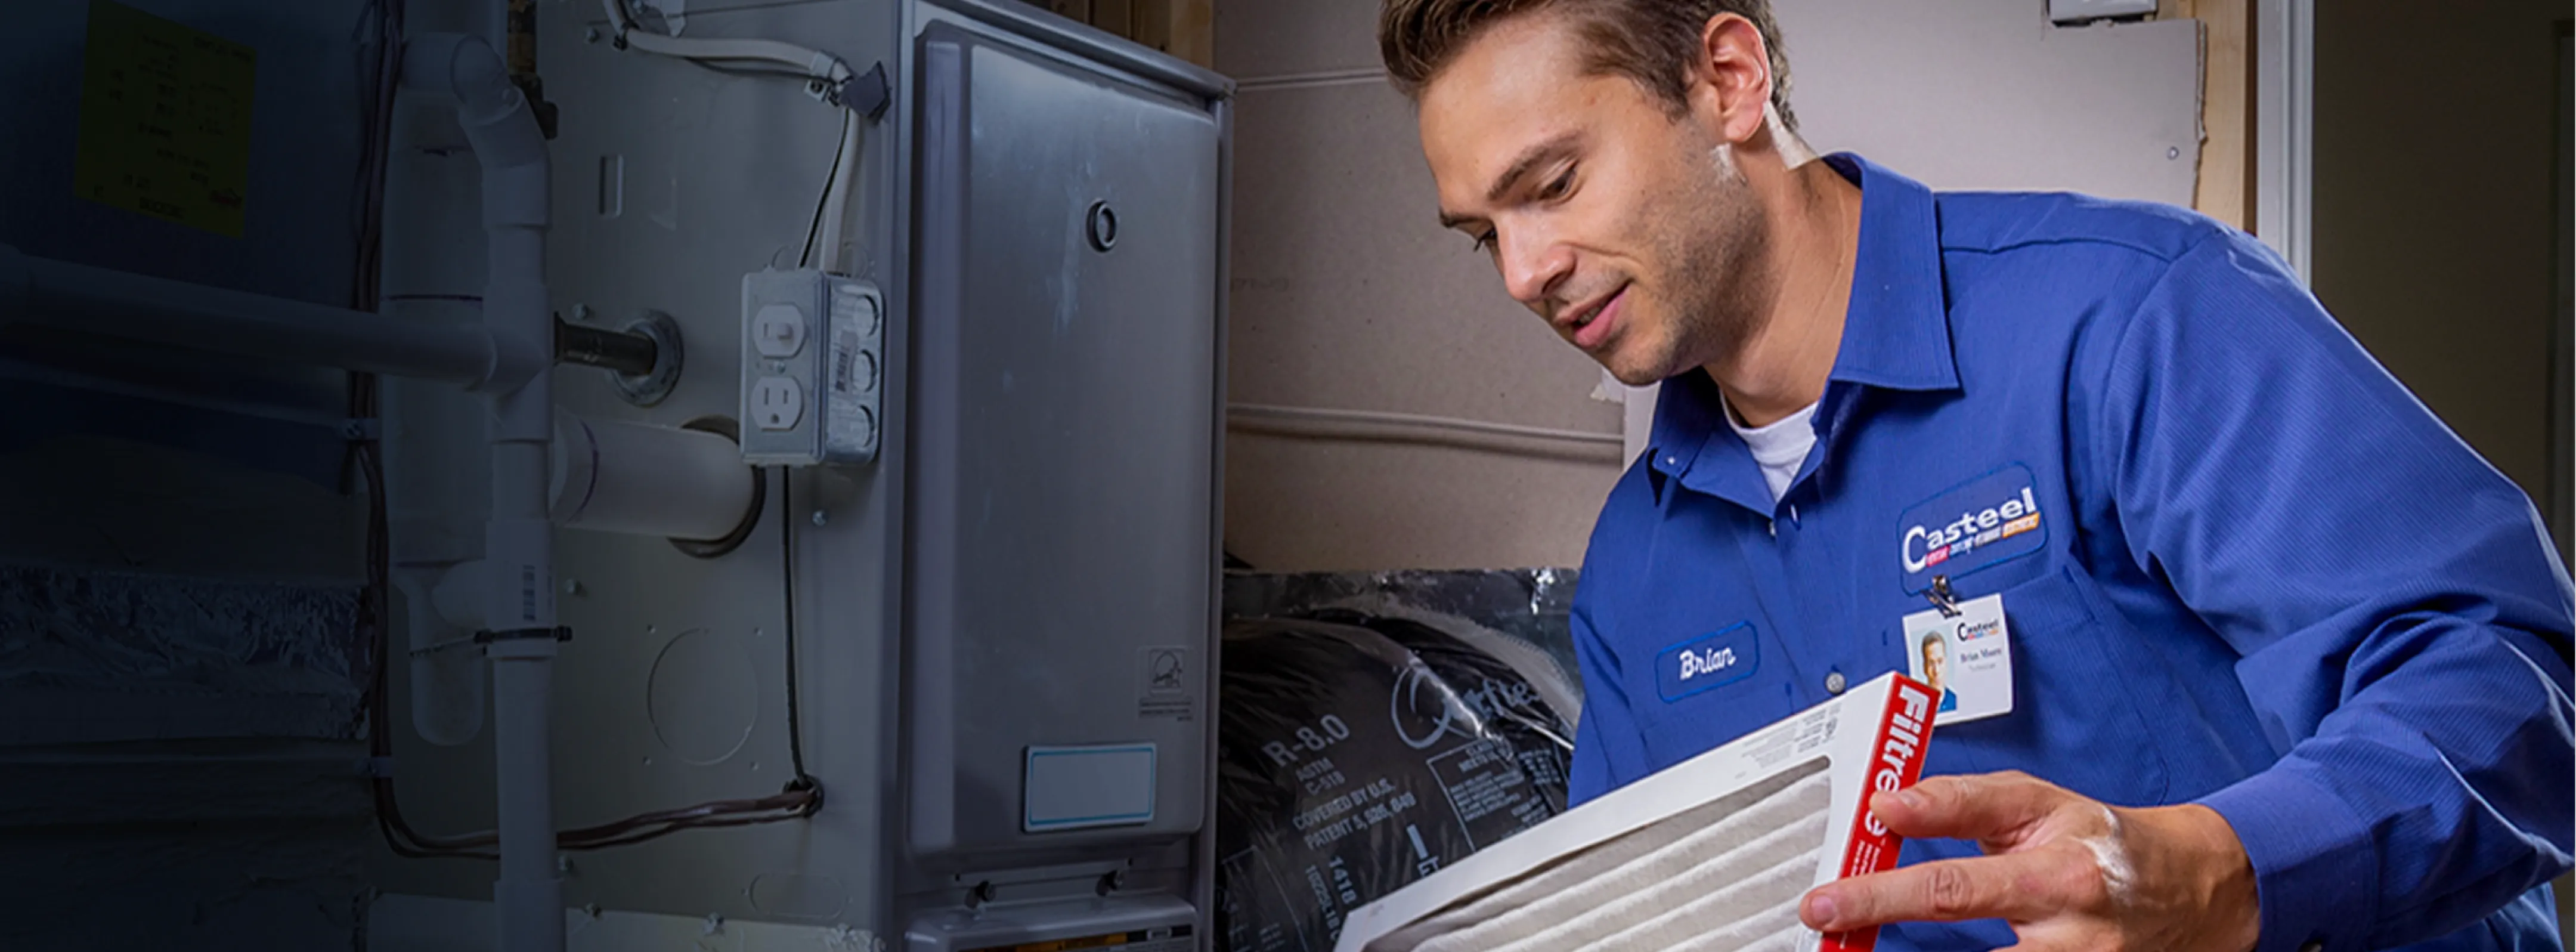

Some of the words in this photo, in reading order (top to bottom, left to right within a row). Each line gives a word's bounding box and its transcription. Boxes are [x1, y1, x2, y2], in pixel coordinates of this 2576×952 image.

[1902, 486, 2038, 574] Casteel
[1679, 646, 1737, 681] Brian
[1262, 714, 1350, 767] R-8.0
[1864, 684, 1930, 837] Filtree
[1296, 757, 1335, 782] ASTM
[1293, 795, 1352, 830] COVERED
[1349, 787, 1368, 806] BY
[1304, 818, 1354, 850] PATENT
